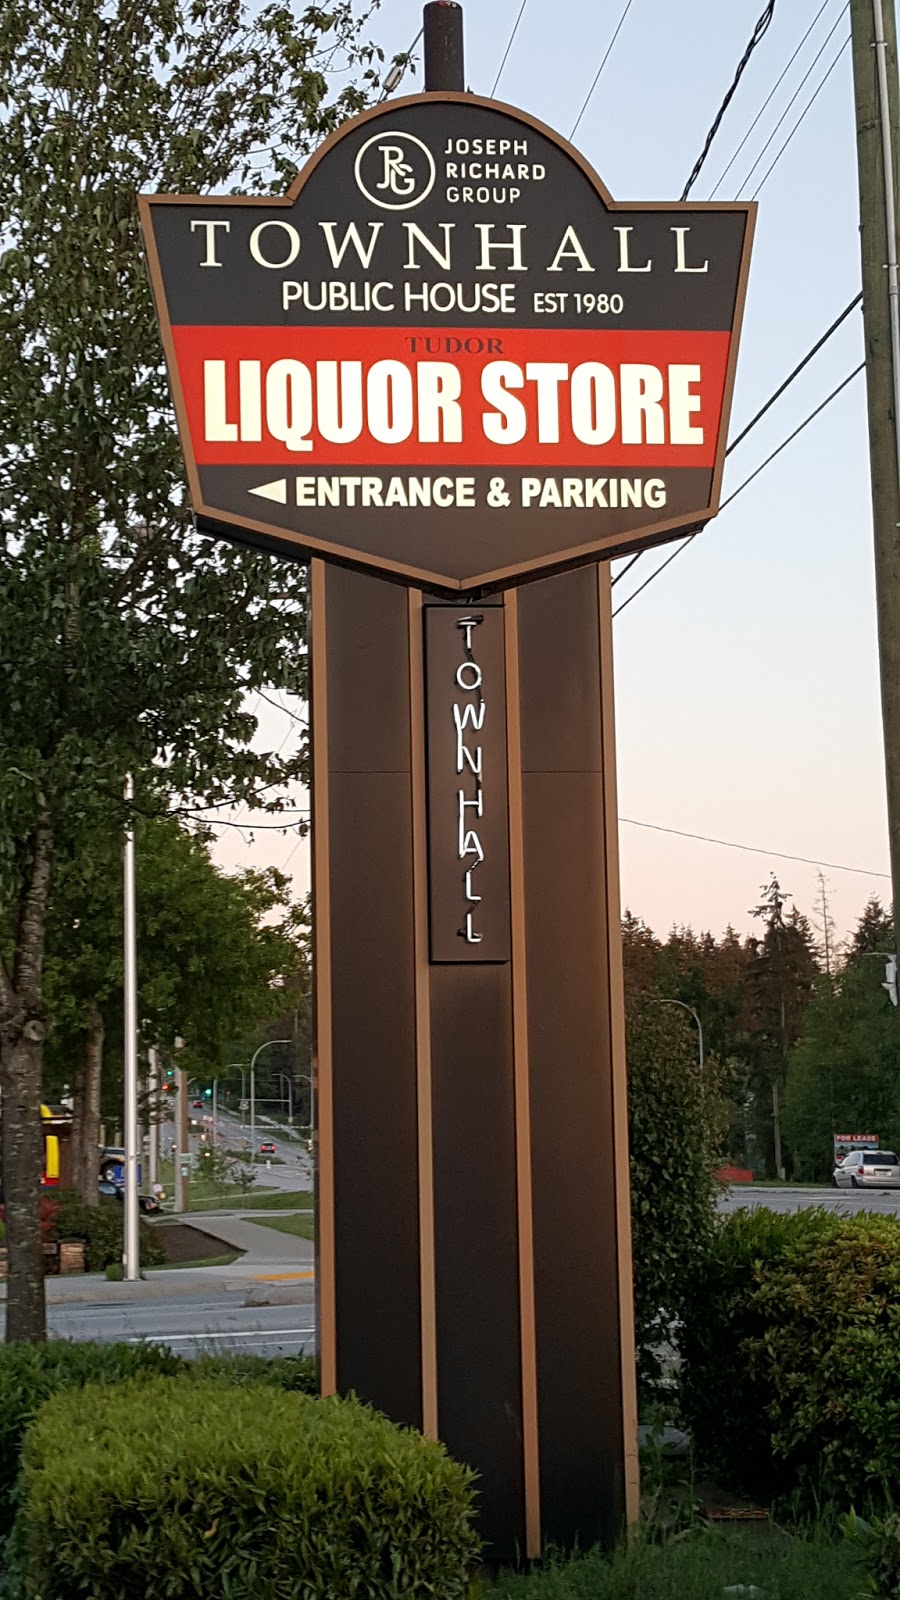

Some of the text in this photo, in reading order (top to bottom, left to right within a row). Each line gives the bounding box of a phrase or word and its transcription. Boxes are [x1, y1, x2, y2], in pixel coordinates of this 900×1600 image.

[444, 138, 529, 157] JOSEPH
[445, 162, 547, 182] RICHARD
[446, 186, 522, 204] GROUP
[190, 219, 710, 274] TOWNHALL
[282, 280, 624, 315] PUBLIC HOUSE EST 1980
[403, 335, 506, 356] TUDOR
[203, 358, 705, 452] LIQUOR STORE
[295, 476, 668, 509] ENTRANCE & PARKING
[452, 616, 486, 944] TOWNHALL
